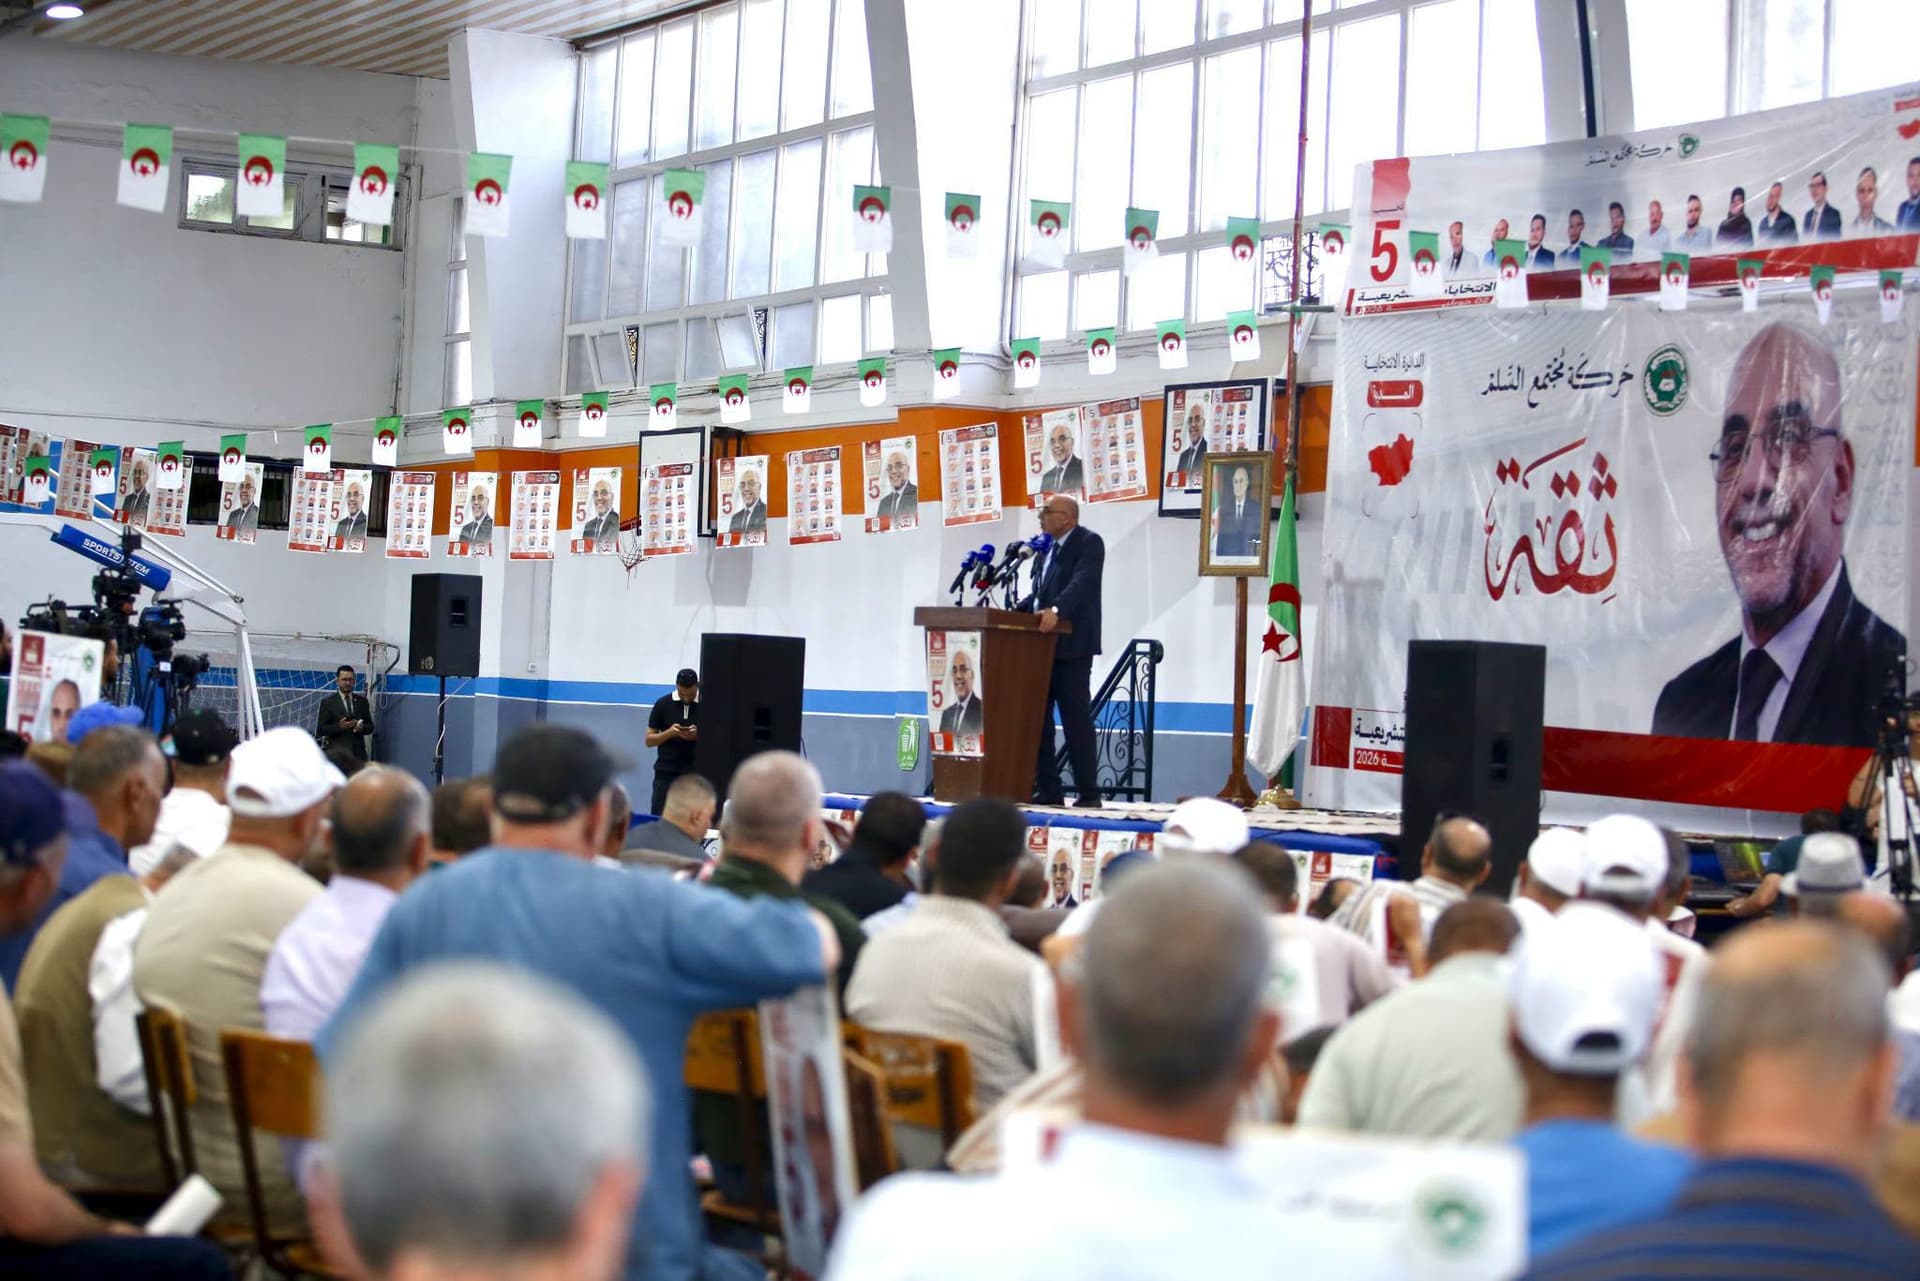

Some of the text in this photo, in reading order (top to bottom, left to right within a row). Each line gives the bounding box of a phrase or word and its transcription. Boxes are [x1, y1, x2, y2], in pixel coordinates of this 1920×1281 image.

[1370, 220, 1400, 282] 5
[1444, 281, 1498, 296] الانتخابا
[1172, 429, 1182, 452] 5
[1030, 451, 1043, 475] 5
[119, 476, 128, 495] 5
[868, 477, 881, 500] 5
[223, 491, 233, 511] 5
[331, 501, 340, 520] 5
[576, 501, 587, 522] 5
[722, 493, 733, 515] 5
[454, 505, 464, 525] 5
[82, 537, 151, 576] SPORTSTEM
[931, 679, 944, 709] 5
[1356, 750, 1379, 767] 2026
